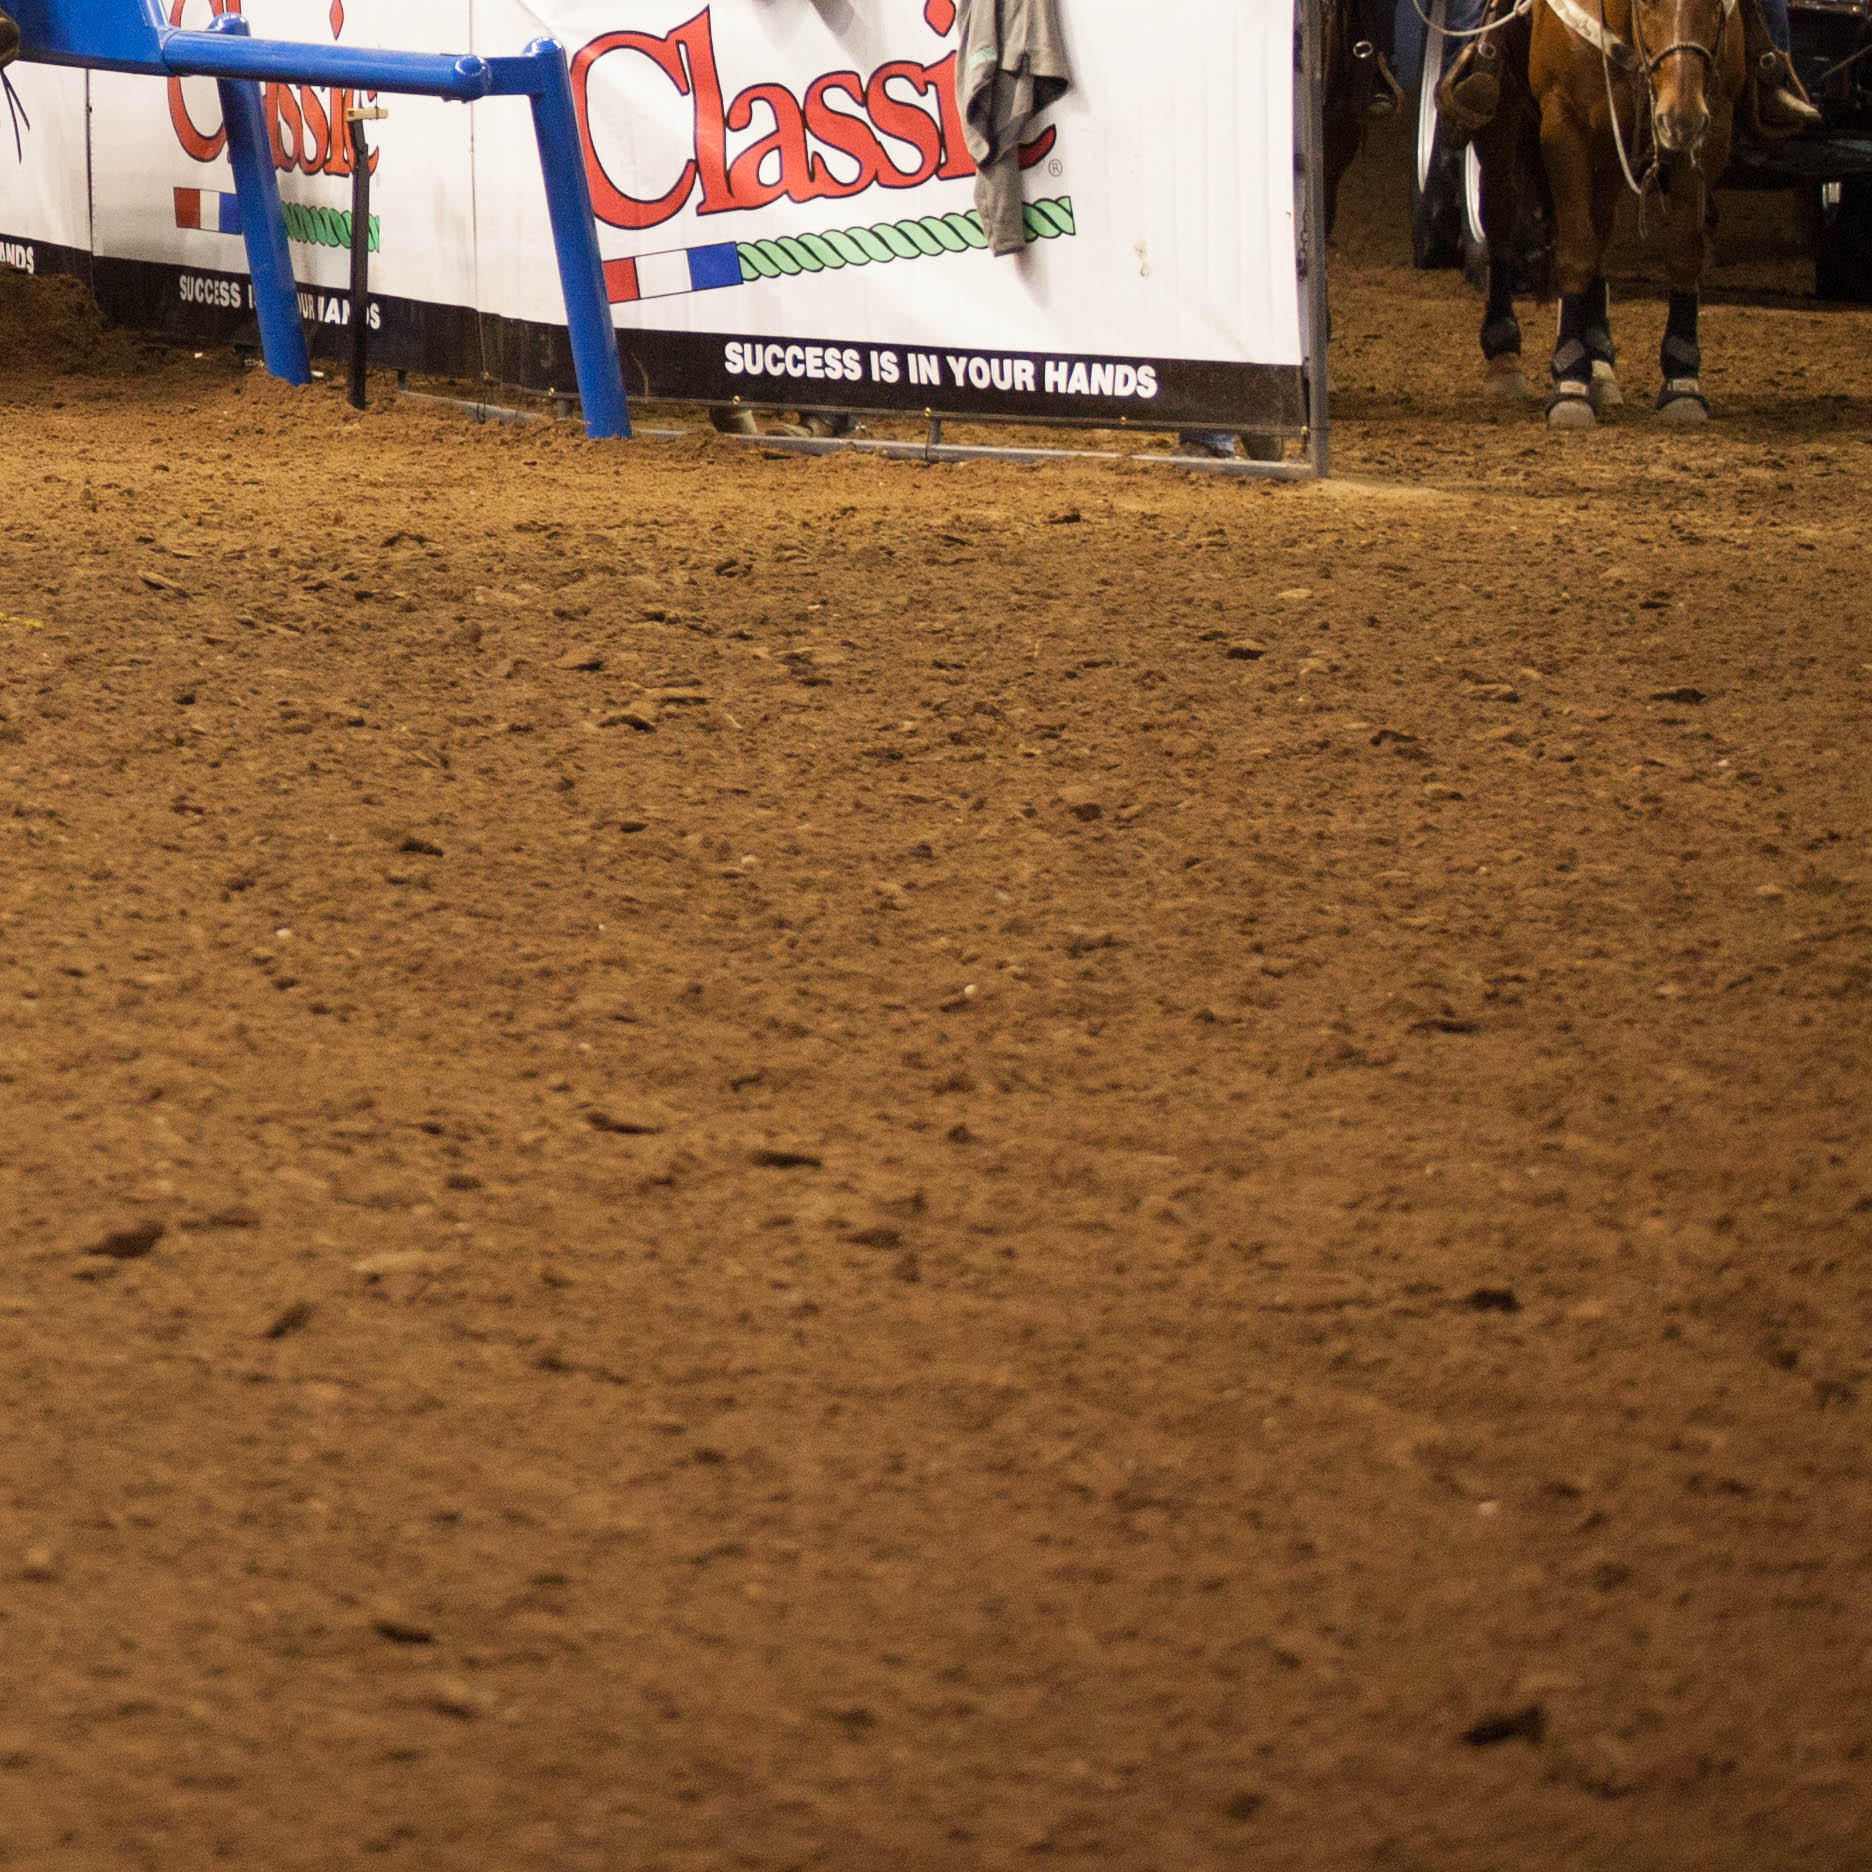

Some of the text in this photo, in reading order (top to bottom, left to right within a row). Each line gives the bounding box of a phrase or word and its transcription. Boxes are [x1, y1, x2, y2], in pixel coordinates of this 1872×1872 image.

[179, 274, 242, 309] SUCCESS
[724, 341, 1158, 399] SUCCESS IS IN YOUR HANDS
